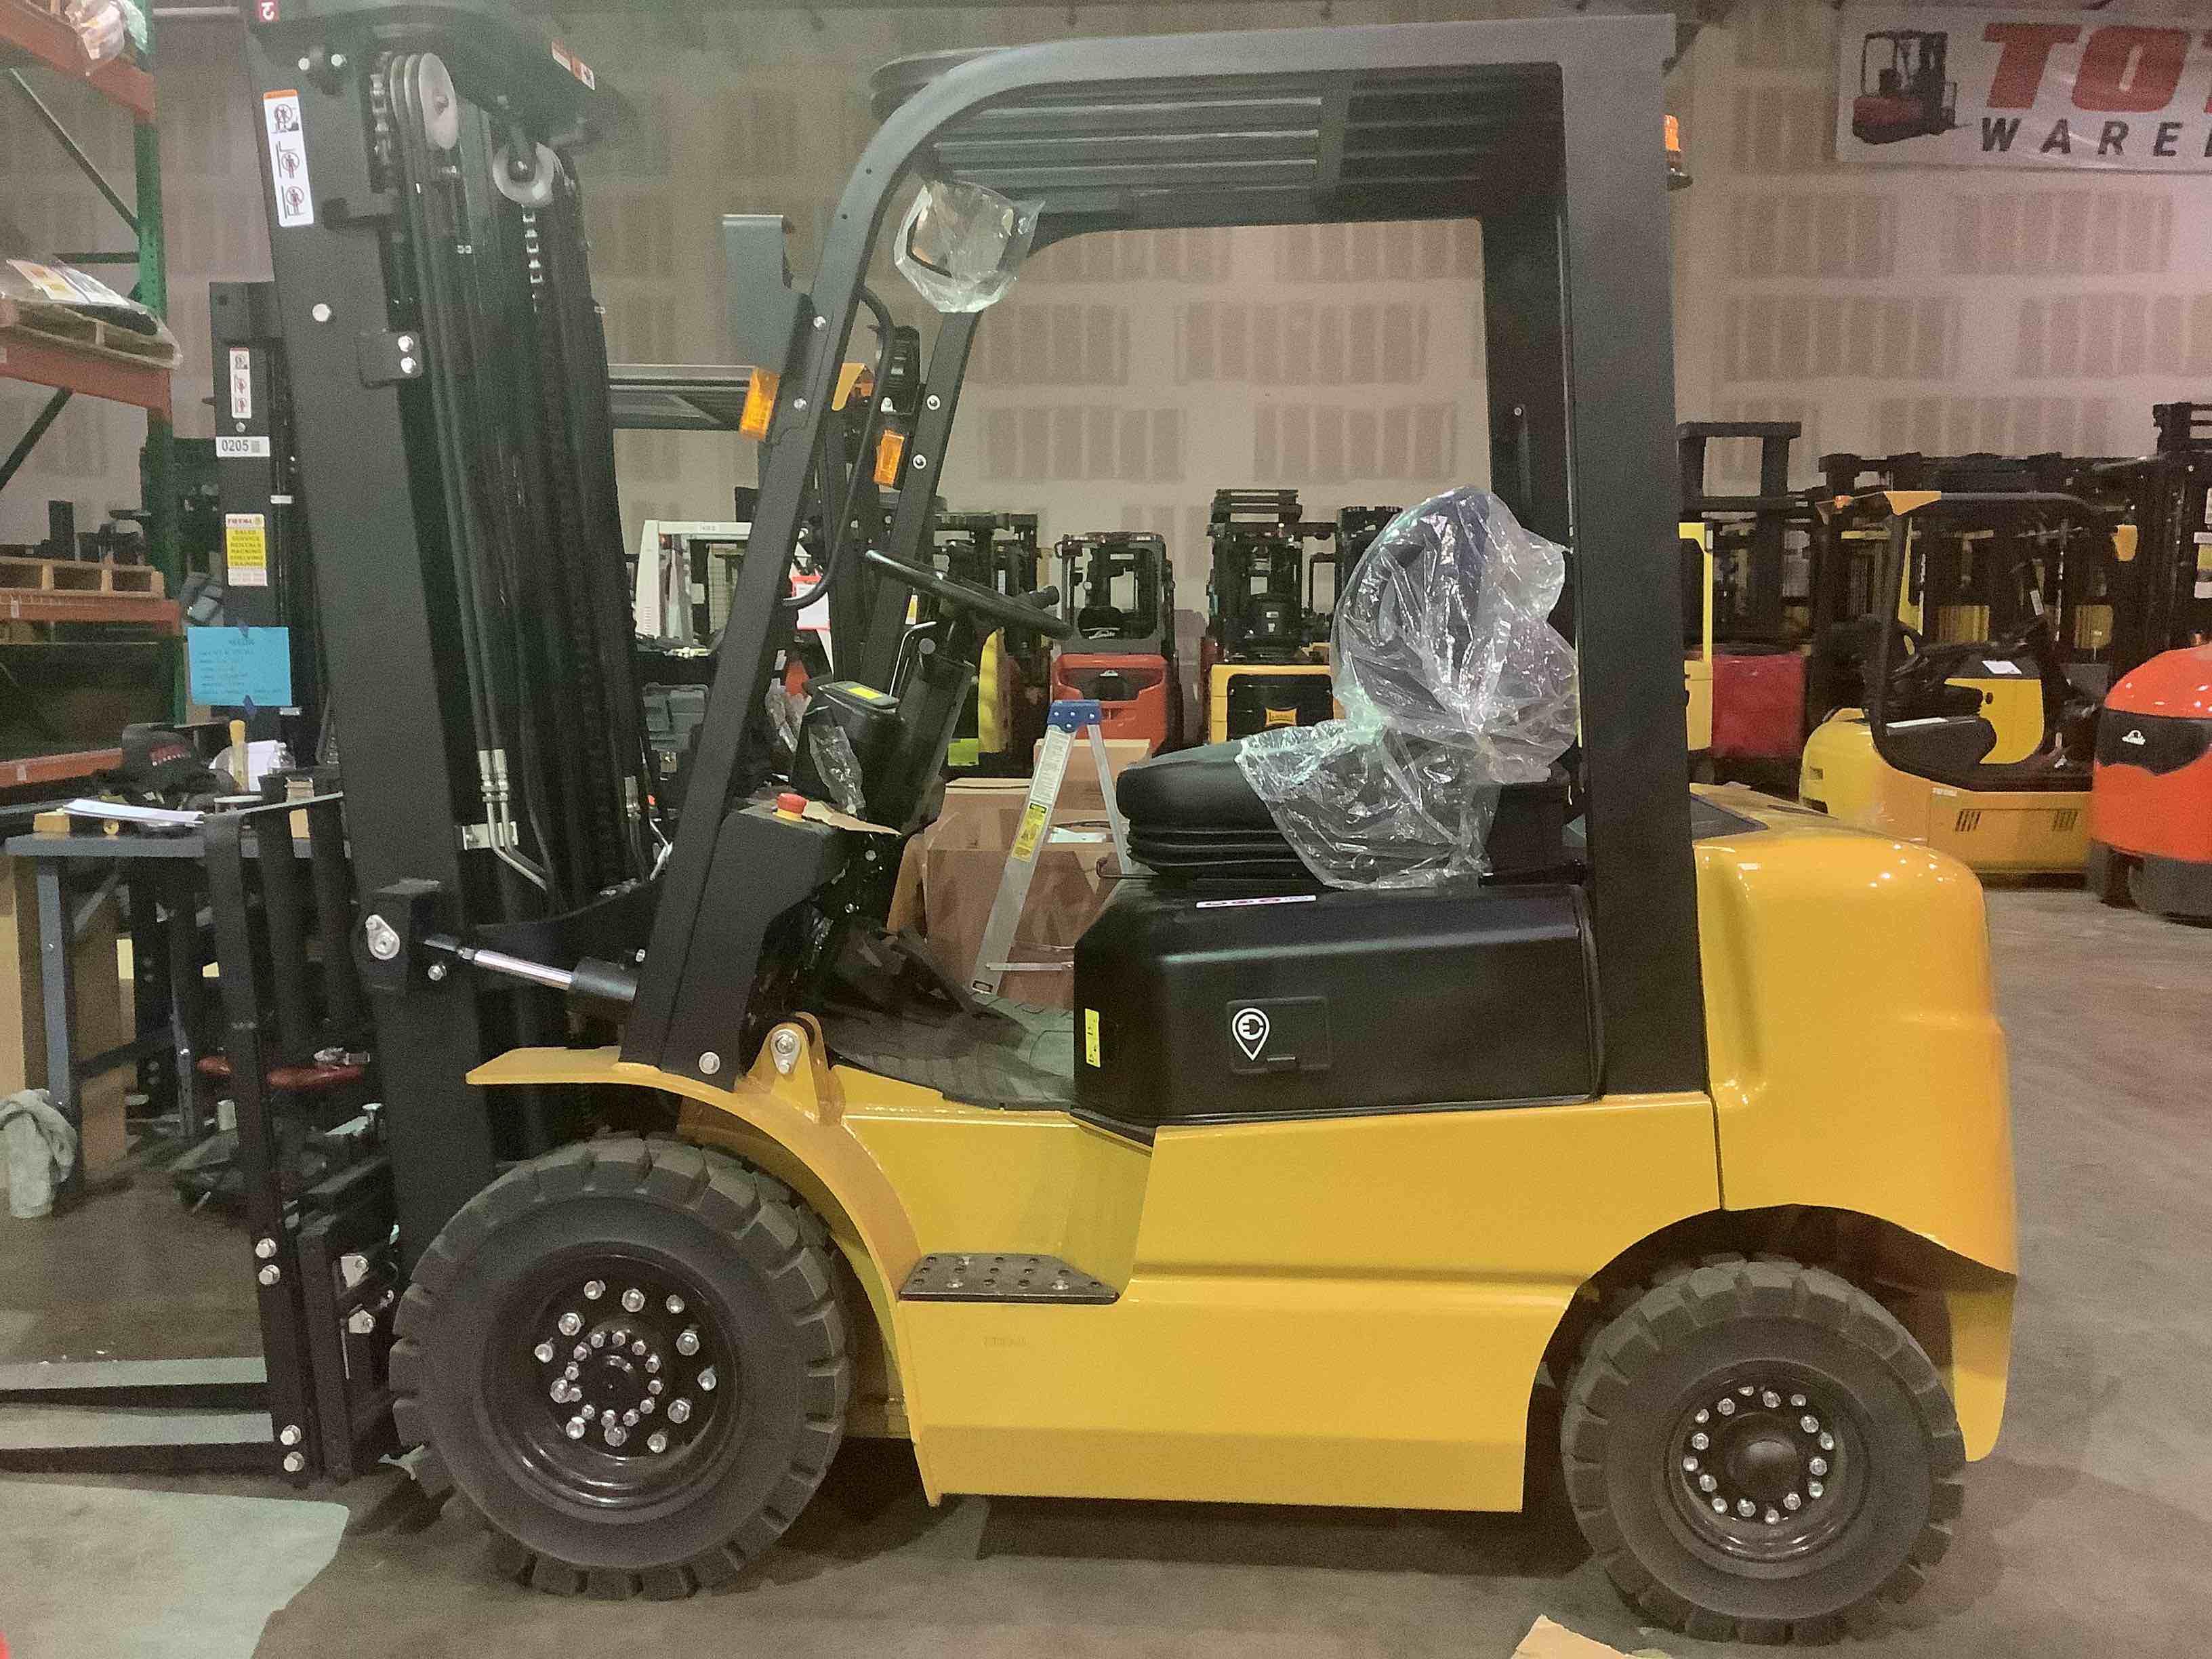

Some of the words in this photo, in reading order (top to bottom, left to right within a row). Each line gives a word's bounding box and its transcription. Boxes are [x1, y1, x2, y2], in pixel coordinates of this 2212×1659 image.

[1985, 23, 2212, 112] TO
[1982, 118, 2212, 157] WARE
[222, 439, 249, 452] 0205
